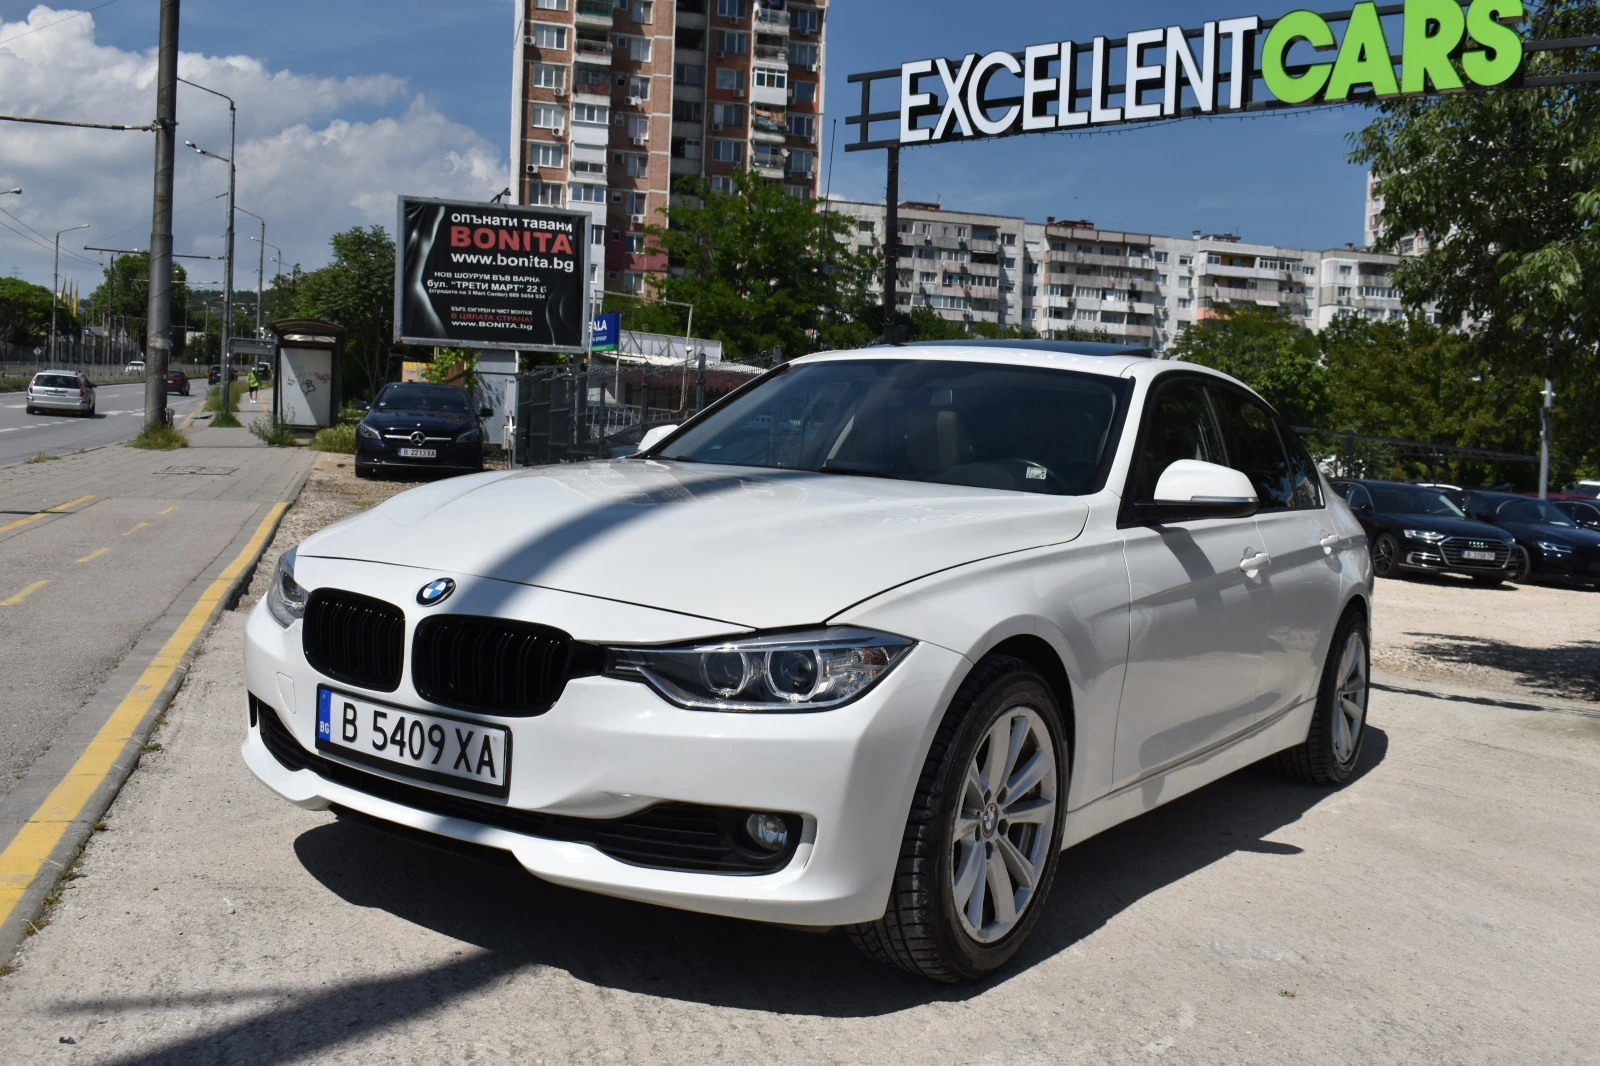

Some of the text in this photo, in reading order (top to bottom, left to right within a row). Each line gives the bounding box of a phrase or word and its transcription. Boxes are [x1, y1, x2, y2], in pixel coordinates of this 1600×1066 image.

[899, 0, 1524, 144] EXCELLENT CARS
[451, 213, 573, 233] опънати тавани
[450, 225, 573, 255] BONITA
[451, 253, 574, 273] www.bonita.bg
[427, 280, 448, 288] бул.
[527, 285, 538, 293] 22
[454, 272, 491, 280] ШОУРУМ
[513, 275, 540, 283] ВАРНА
[451, 321, 533, 331] www.BONITA.bg
[319, 720, 330, 734] BG
[342, 701, 496, 778] B 5409 XA
